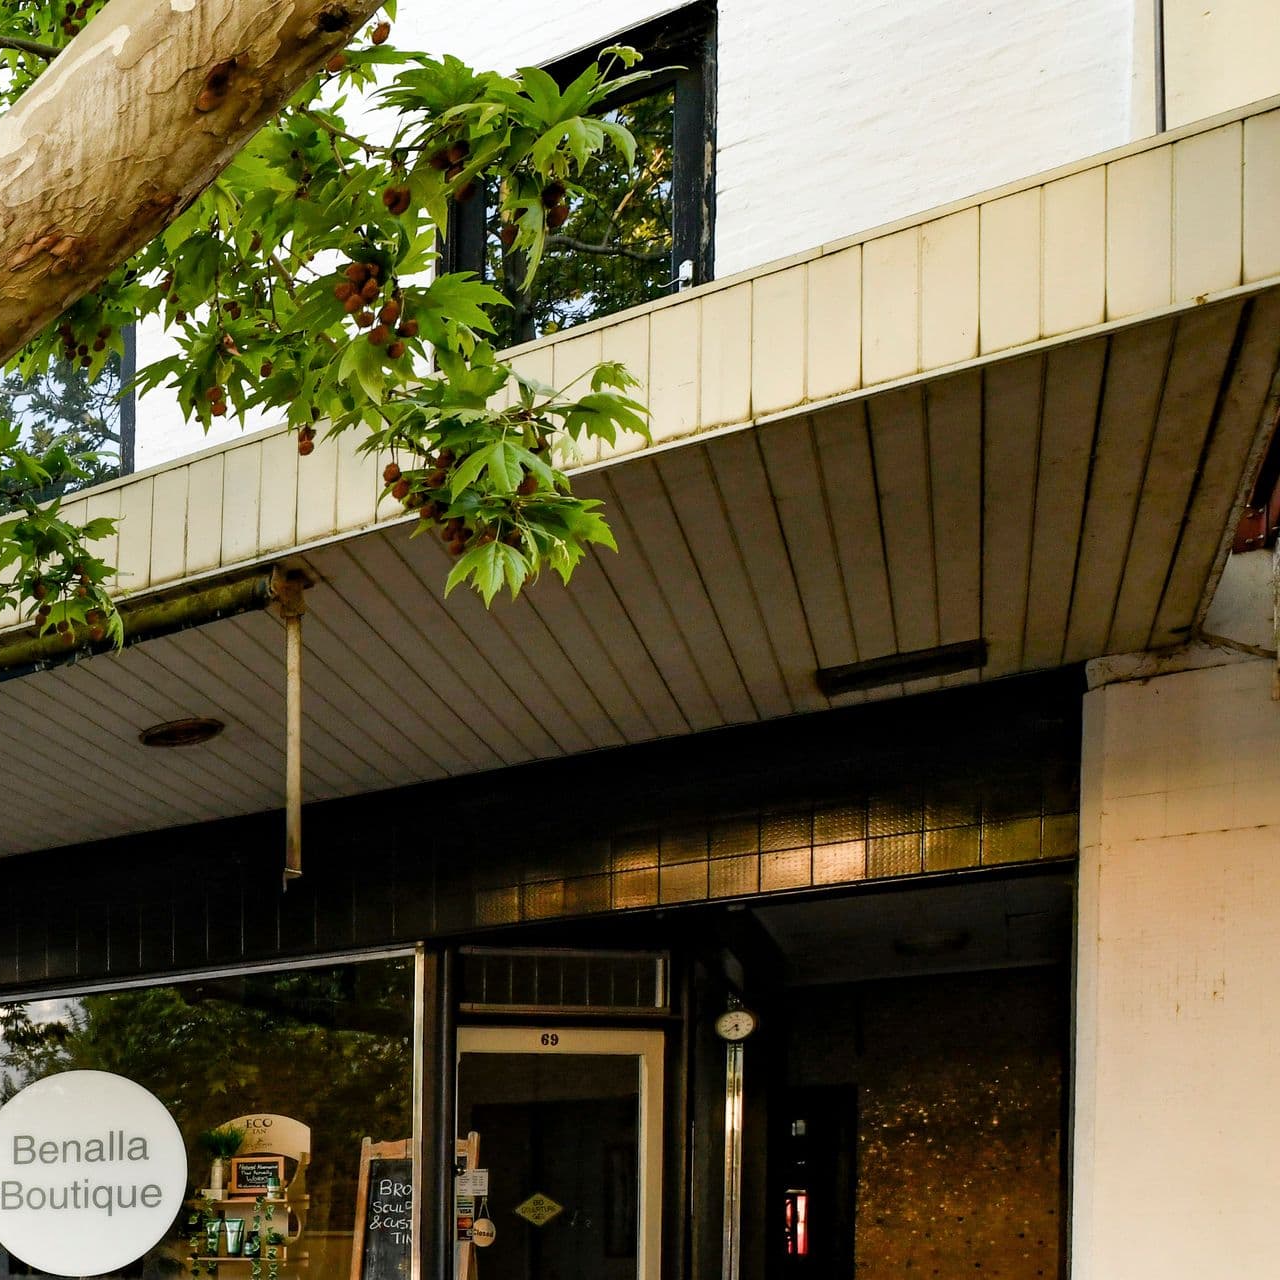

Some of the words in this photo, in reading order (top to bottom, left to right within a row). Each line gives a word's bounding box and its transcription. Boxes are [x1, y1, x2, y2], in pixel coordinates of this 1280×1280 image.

[541, 1033, 559, 1046] 69
[246, 1119, 272, 1129] ECO
[13, 1130, 150, 1165] Benalla
[1, 1179, 163, 1217] Boutique
[474, 1228, 494, 1238] Closed
